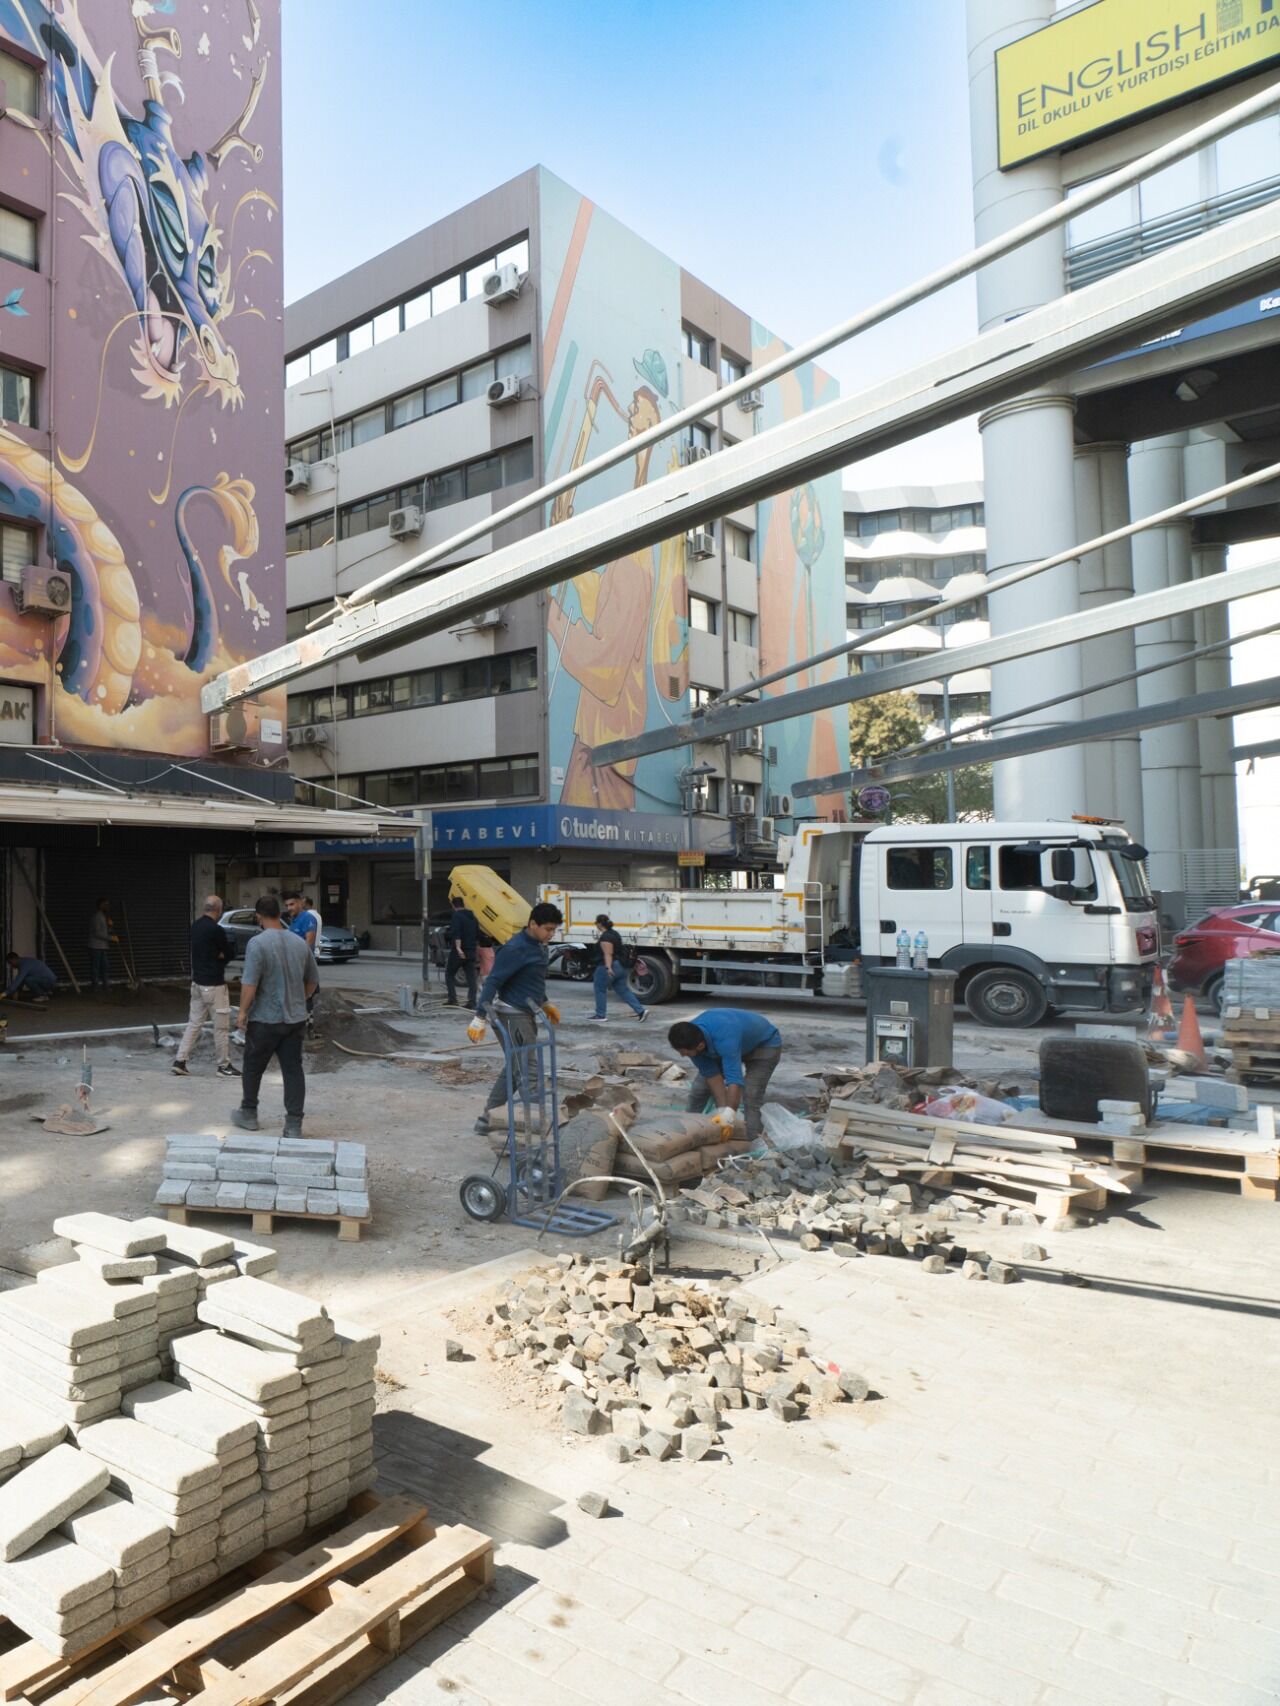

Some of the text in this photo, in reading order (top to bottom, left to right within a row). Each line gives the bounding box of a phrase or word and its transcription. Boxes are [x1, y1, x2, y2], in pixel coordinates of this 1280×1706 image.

[1017, 12, 1206, 120] ENGLISH
[1018, 119, 1040, 136] DİL
[1042, 95, 1091, 125] OKULU
[1096, 87, 1114, 103] VE
[1117, 54, 1190, 93] YURTDIŞI
[1194, 27, 1252, 62] EĞİTİM
[433, 822, 536, 841] İTABEVİ
[573, 817, 618, 841] tudem
